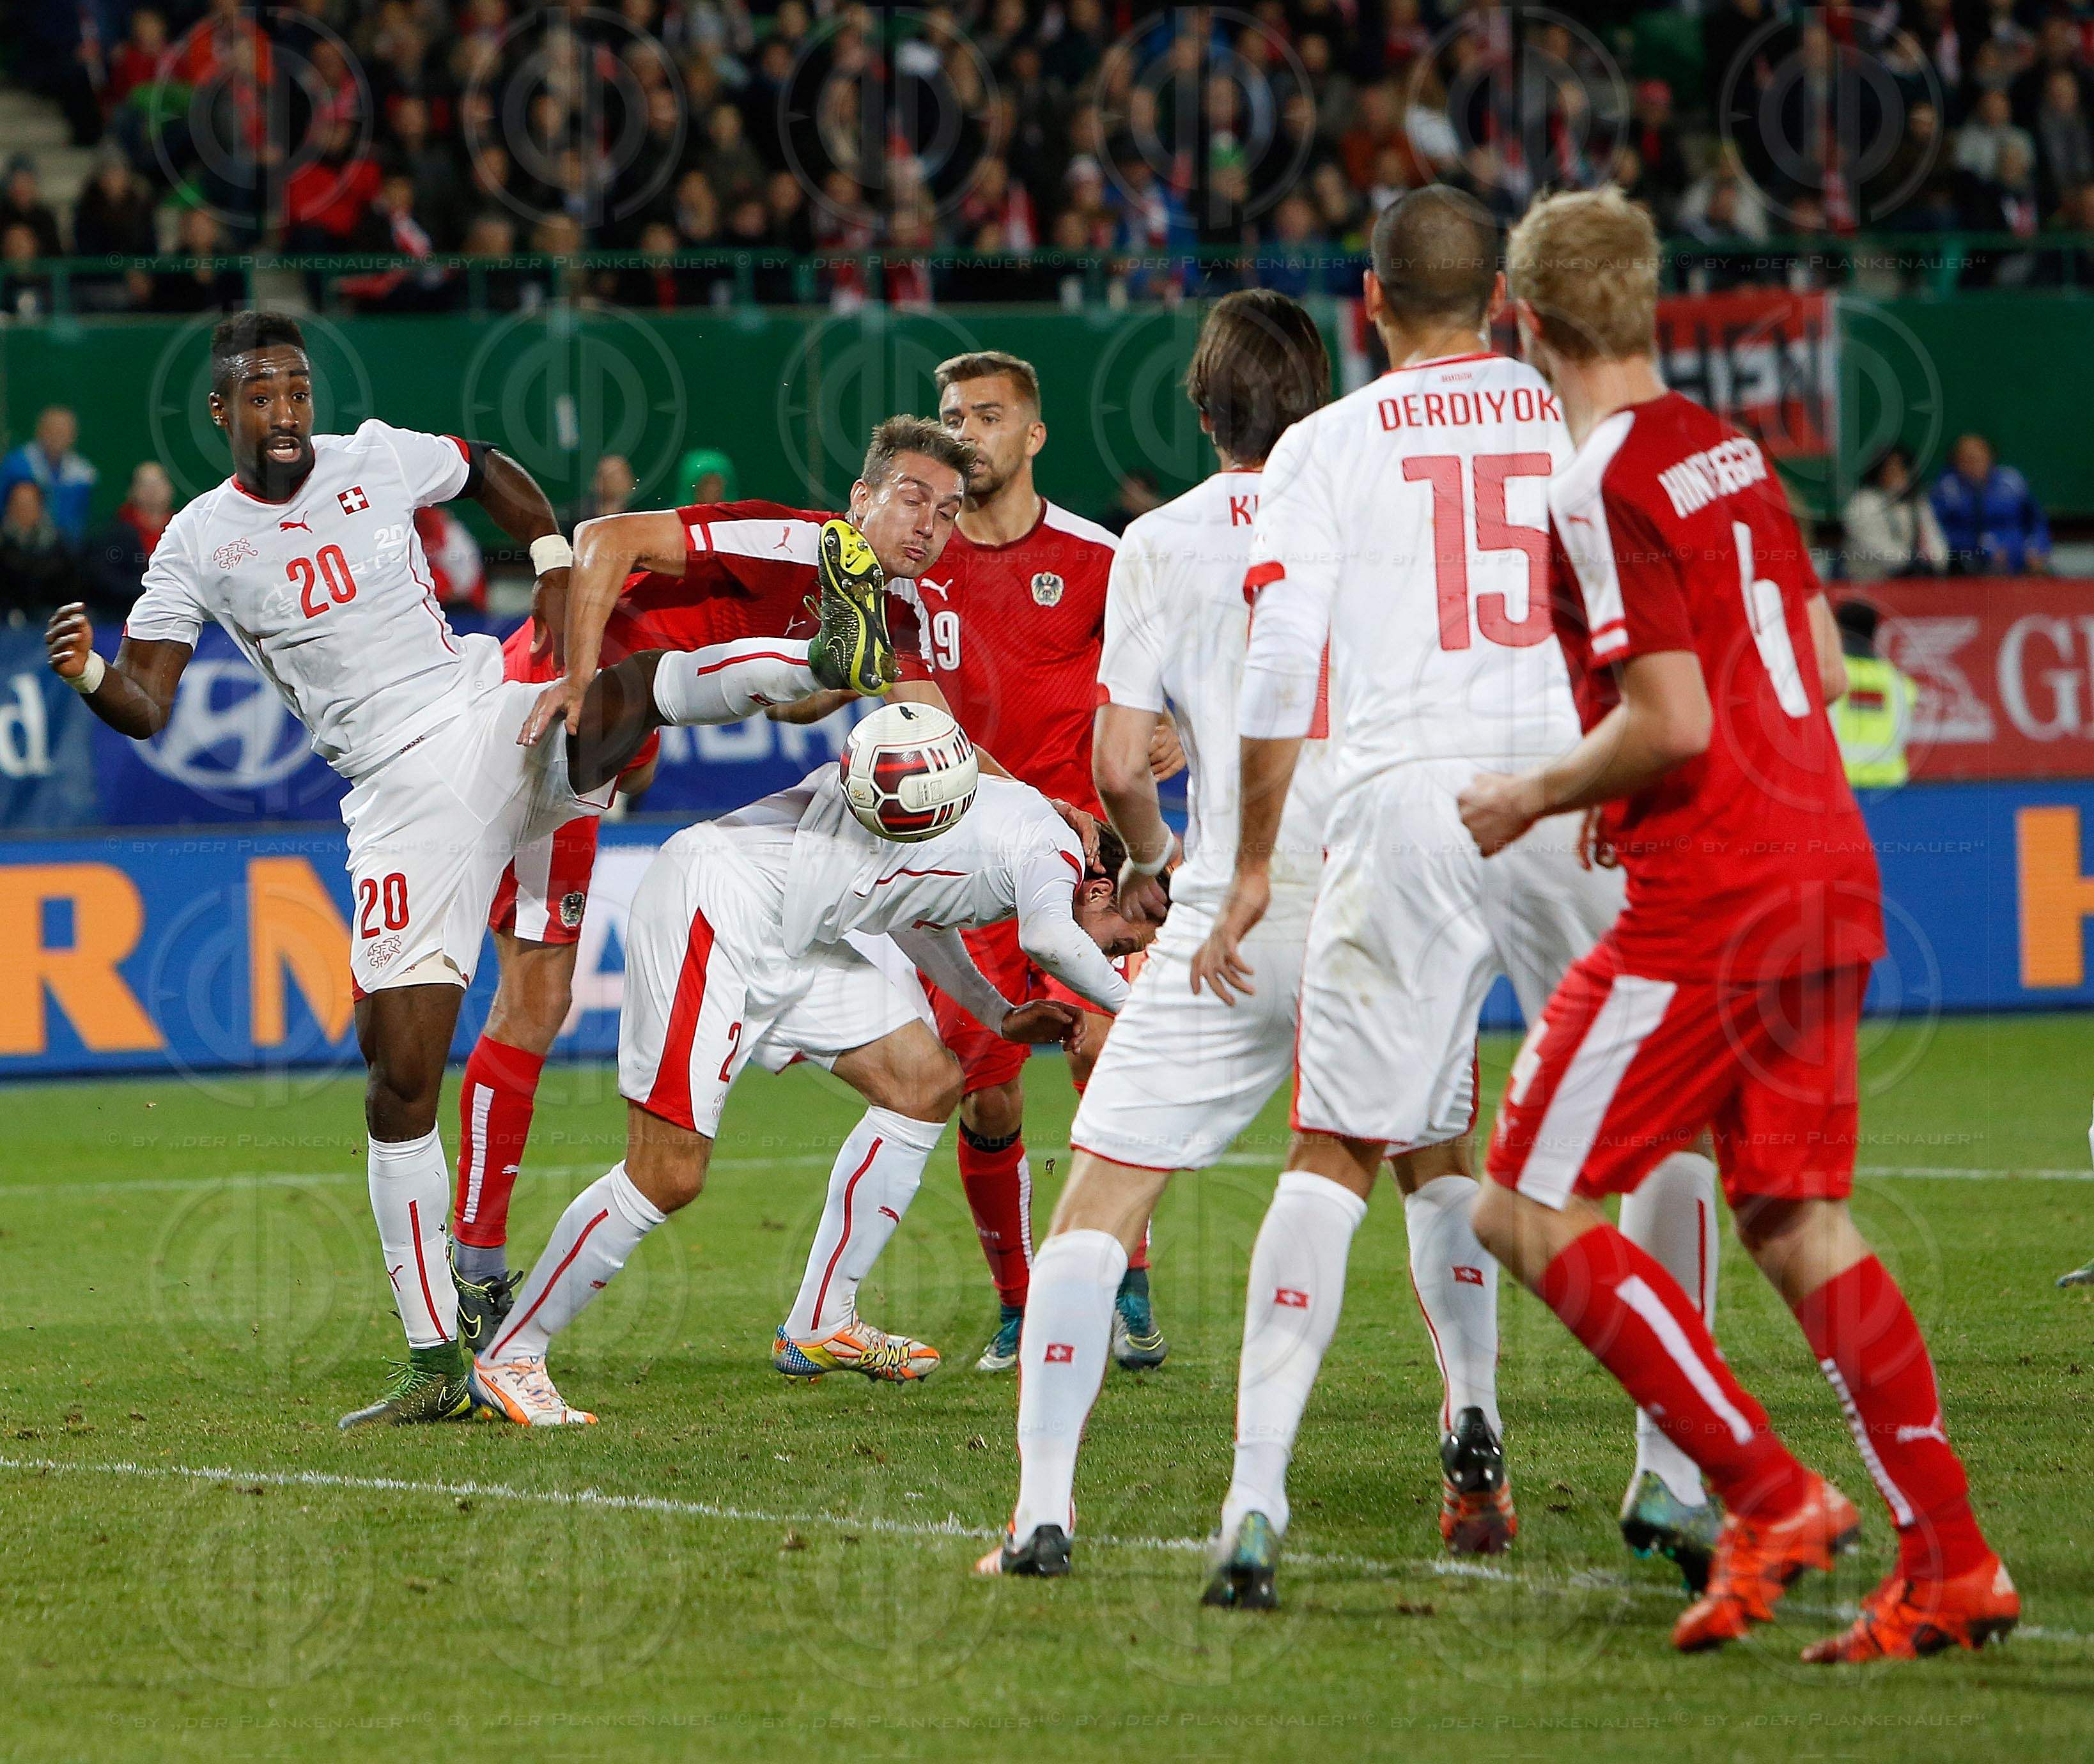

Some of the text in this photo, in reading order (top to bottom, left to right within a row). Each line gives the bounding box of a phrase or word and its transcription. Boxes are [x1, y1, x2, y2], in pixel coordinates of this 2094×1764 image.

[1377, 387, 1561, 432] DERDIYOK
[1229, 493, 1259, 526] K
[285, 543, 358, 619] 20
[1402, 451, 1553, 651] 15
[359, 872, 410, 940] 20
[718, 1021, 742, 1083] 2
